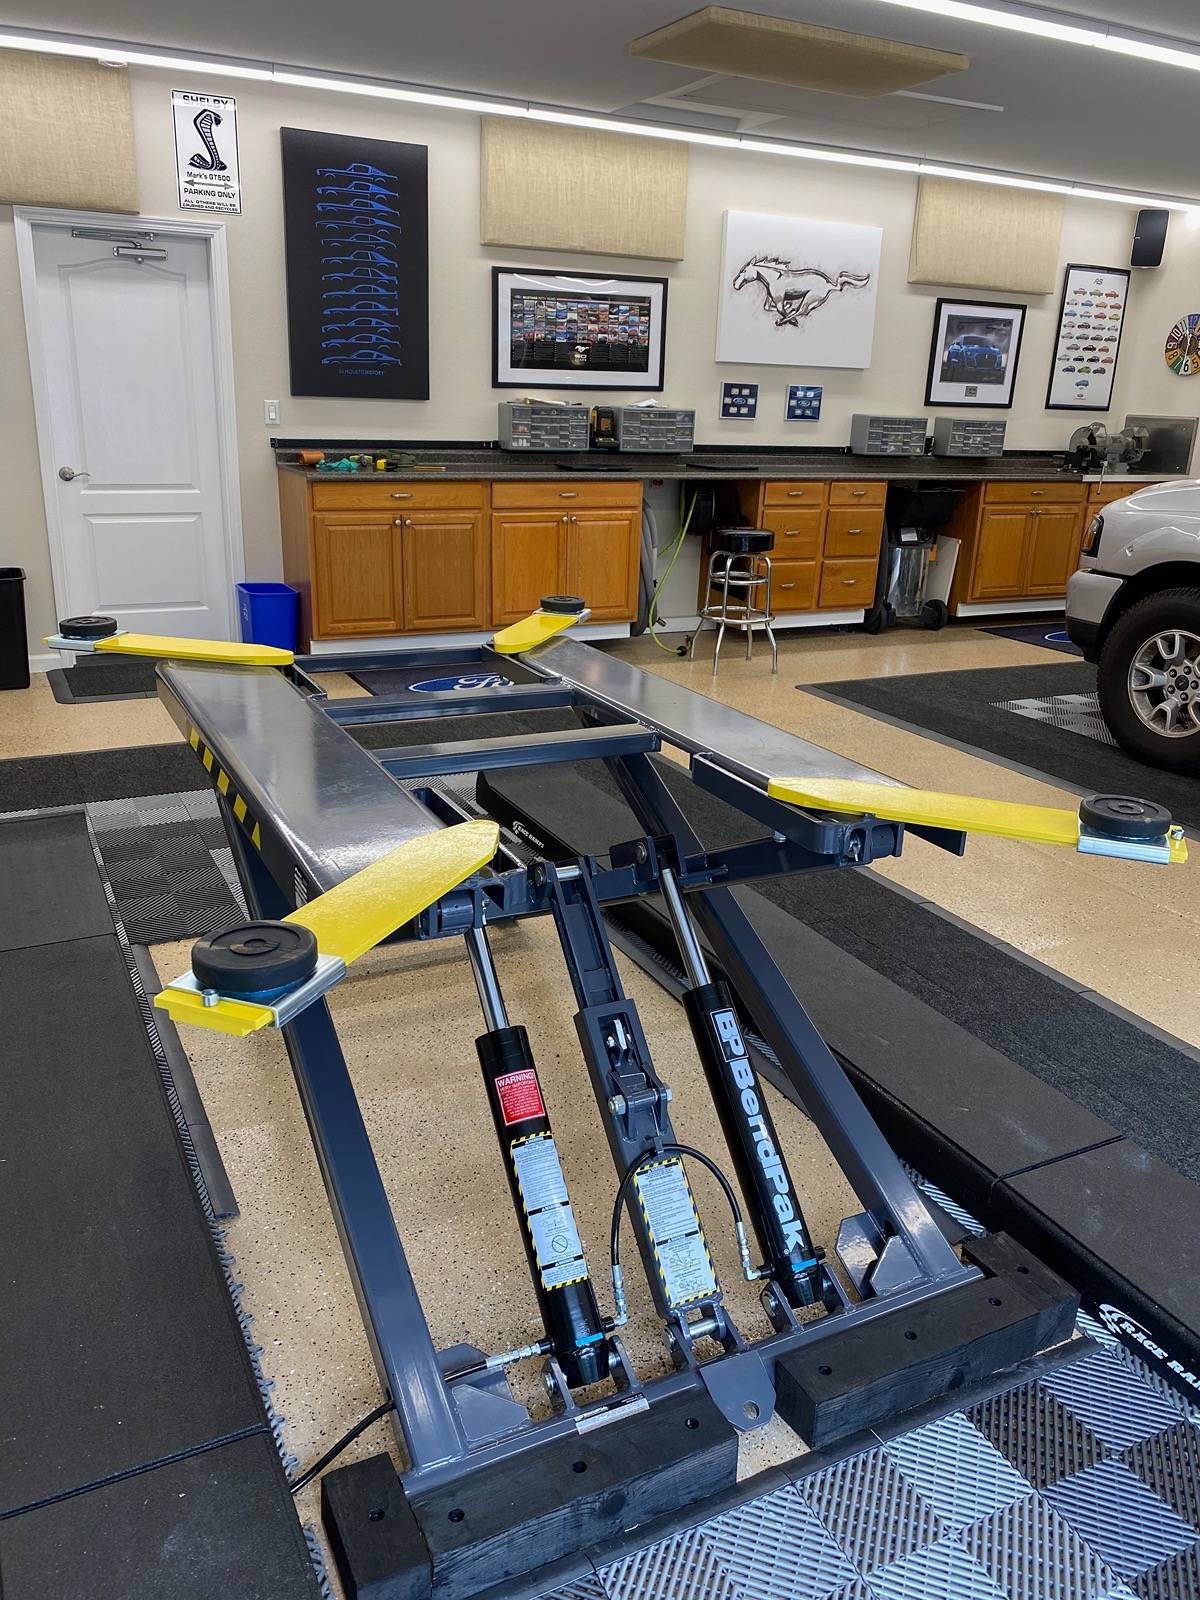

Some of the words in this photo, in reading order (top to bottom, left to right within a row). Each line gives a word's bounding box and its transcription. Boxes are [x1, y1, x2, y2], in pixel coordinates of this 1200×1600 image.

[182, 95, 229, 107] SHELBY
[186, 171, 208, 180] Mark's
[209, 174, 231, 182] GT500
[184, 188, 216, 197] PARKING
[217, 190, 236, 199] ONLY
[1171, 328, 1181, 340] 10
[1183, 359, 1190, 373] 6
[714, 1011, 745, 1056] BP
[729, 1058, 805, 1253] BendPak
[1119, 1321, 1169, 1360] RACE
